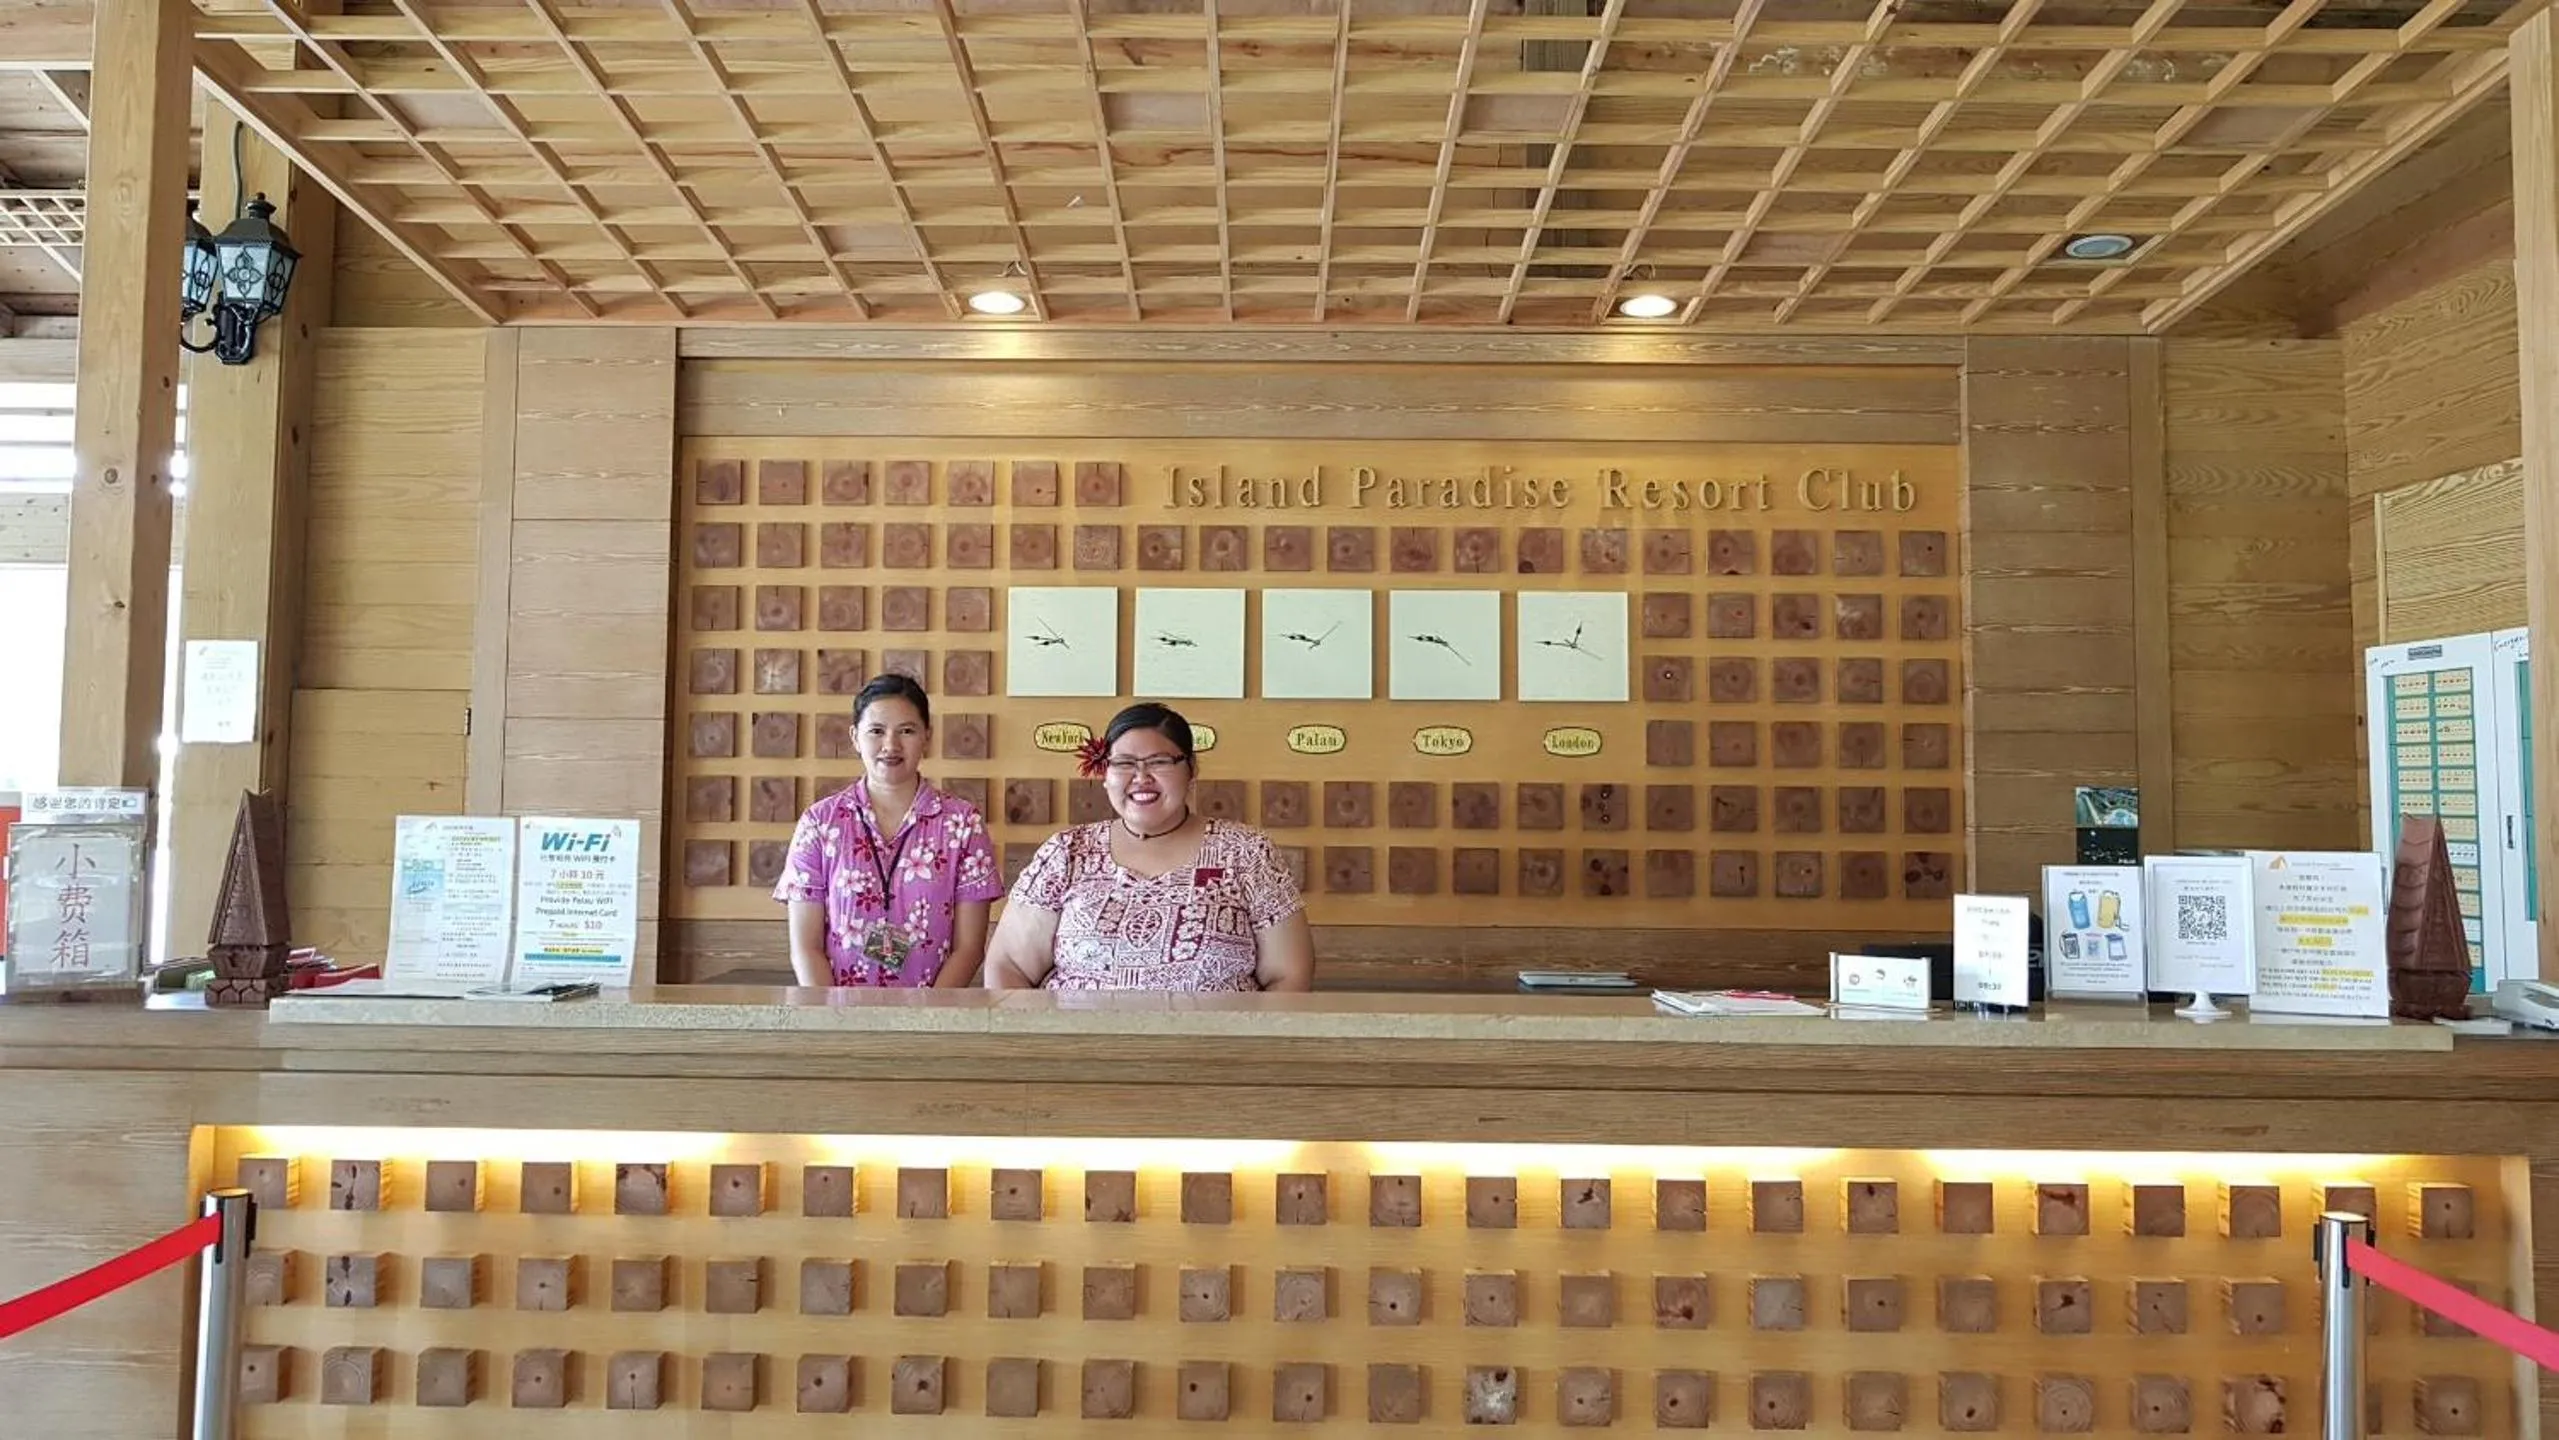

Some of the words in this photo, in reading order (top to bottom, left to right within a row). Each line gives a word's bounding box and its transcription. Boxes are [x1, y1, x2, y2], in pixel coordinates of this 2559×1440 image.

[1162, 464, 1322, 510] Island
[1348, 464, 1571, 510] Paradise
[1599, 467, 1773, 511] Resort
[1799, 467, 1916, 512] Club
[1295, 732, 1337, 747] Palau
[1421, 733, 1465, 749] Tokyo
[1551, 734, 1595, 749] London
[541, 831, 611, 852] Wi-Fi
[581, 869, 592, 880] 10
[50, 843, 97, 969] 小费箱
[573, 896, 593, 905] Palau
[535, 907, 565, 915] Prepaid
[567, 908, 597, 916] Internet
[599, 908, 618, 917] Card
[584, 919, 603, 930] $10
